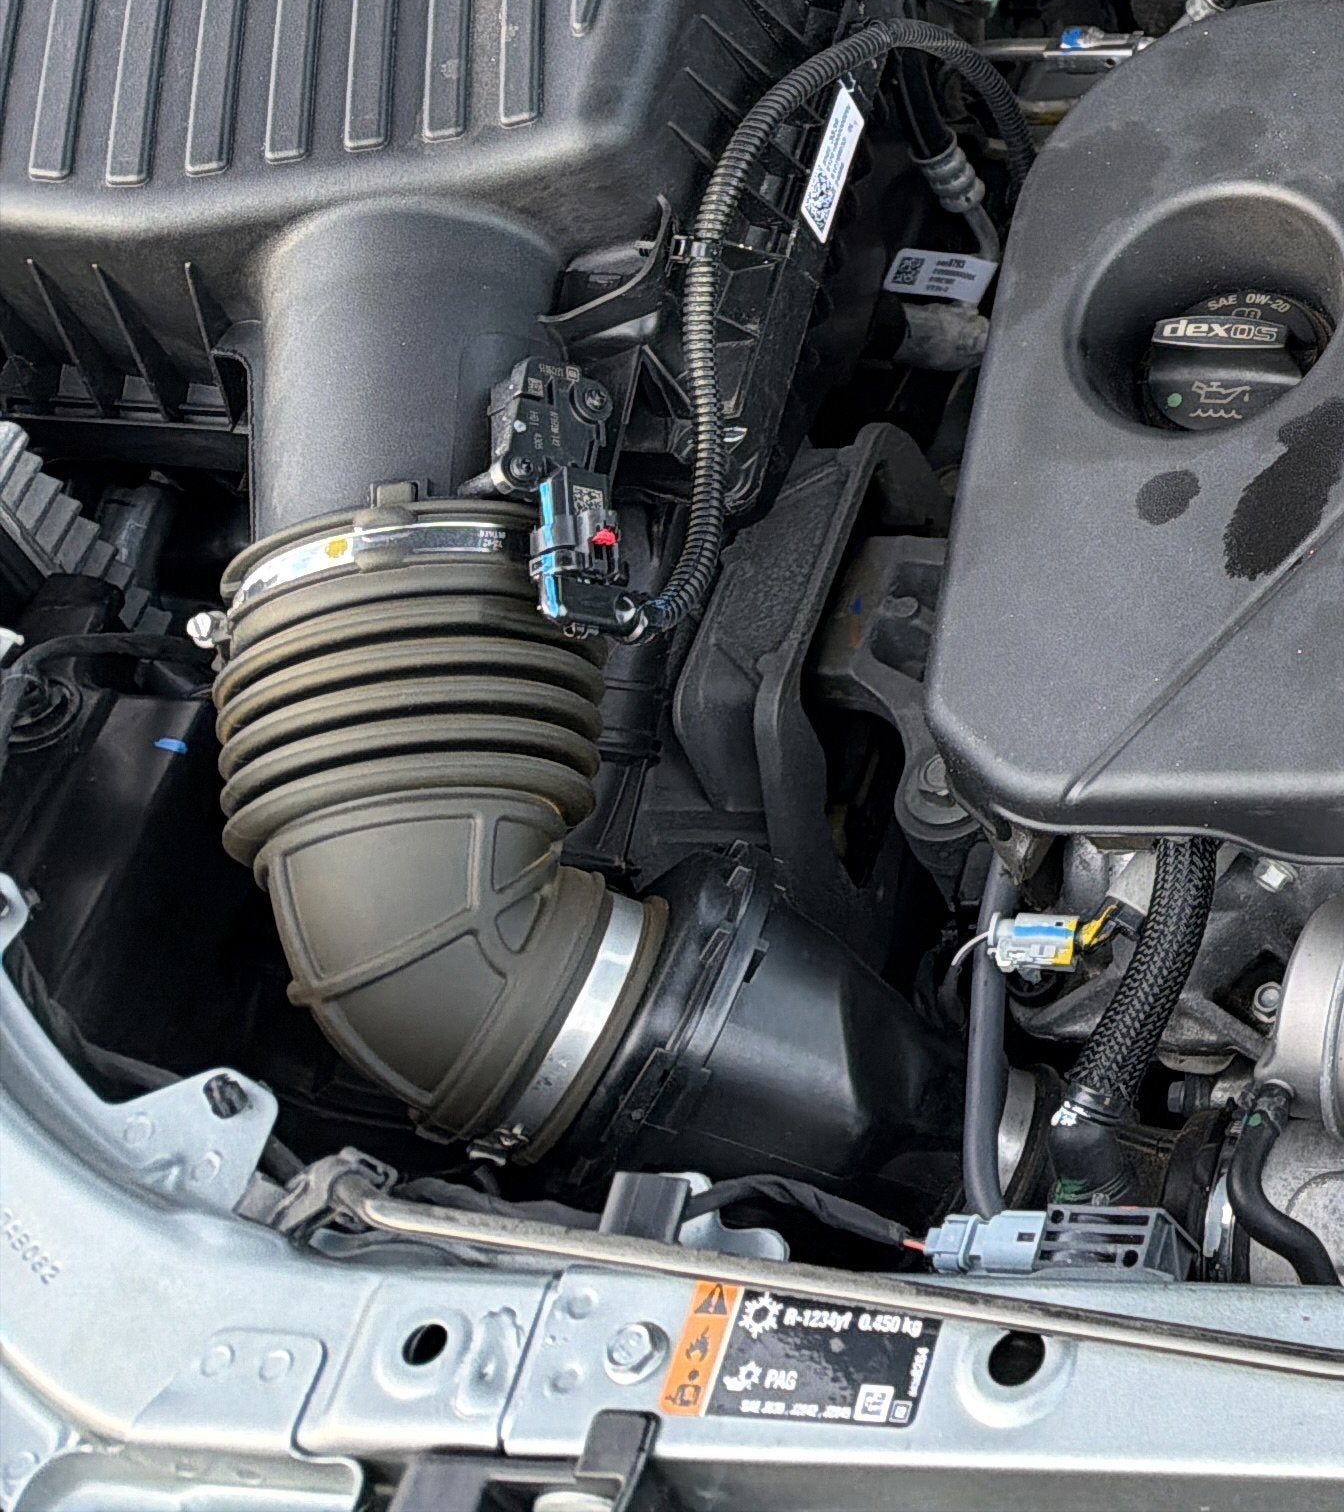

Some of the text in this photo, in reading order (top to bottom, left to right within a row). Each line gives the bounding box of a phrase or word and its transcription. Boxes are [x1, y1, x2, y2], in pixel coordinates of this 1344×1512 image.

[1207, 292, 1292, 314] SAE 0W-20
[1162, 318, 1278, 343] dexos
[783, 1307, 852, 1333] R-1234yf
[902, 1315, 923, 1339] kg
[764, 1368, 799, 1391] PAG
